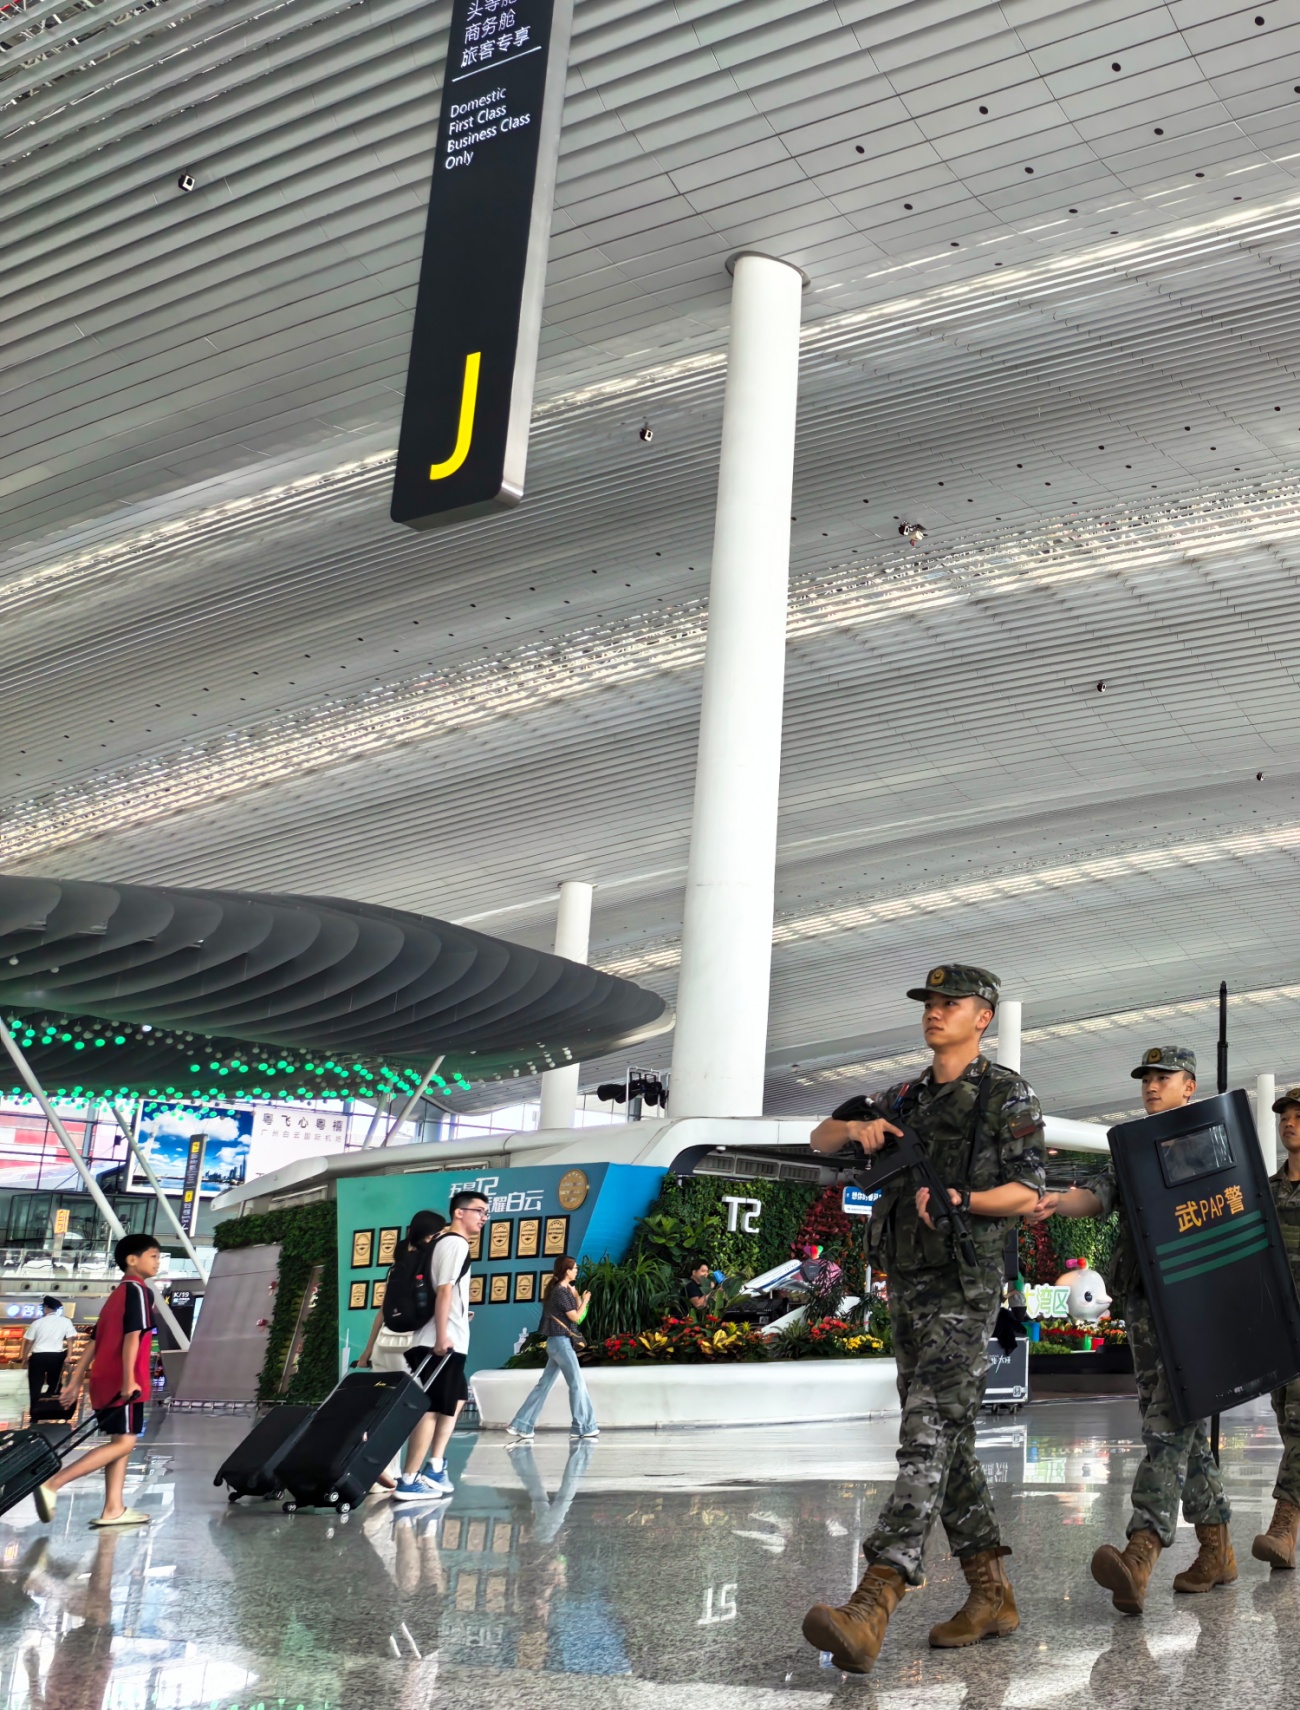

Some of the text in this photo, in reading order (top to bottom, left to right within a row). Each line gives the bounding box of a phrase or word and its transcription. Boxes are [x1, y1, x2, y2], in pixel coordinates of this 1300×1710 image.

[464, 9, 516, 44] 商务舱
[461, 26, 531, 68] 旅客专享
[449, 105, 507, 135] First Class
[450, 87, 507, 118] Domestic
[447, 113, 531, 152] Business Class
[445, 151, 474, 170] Only
[430, 352, 481, 480] J
[488, 1190, 544, 1212] 耀白云
[722, 1195, 761, 1233] T2
